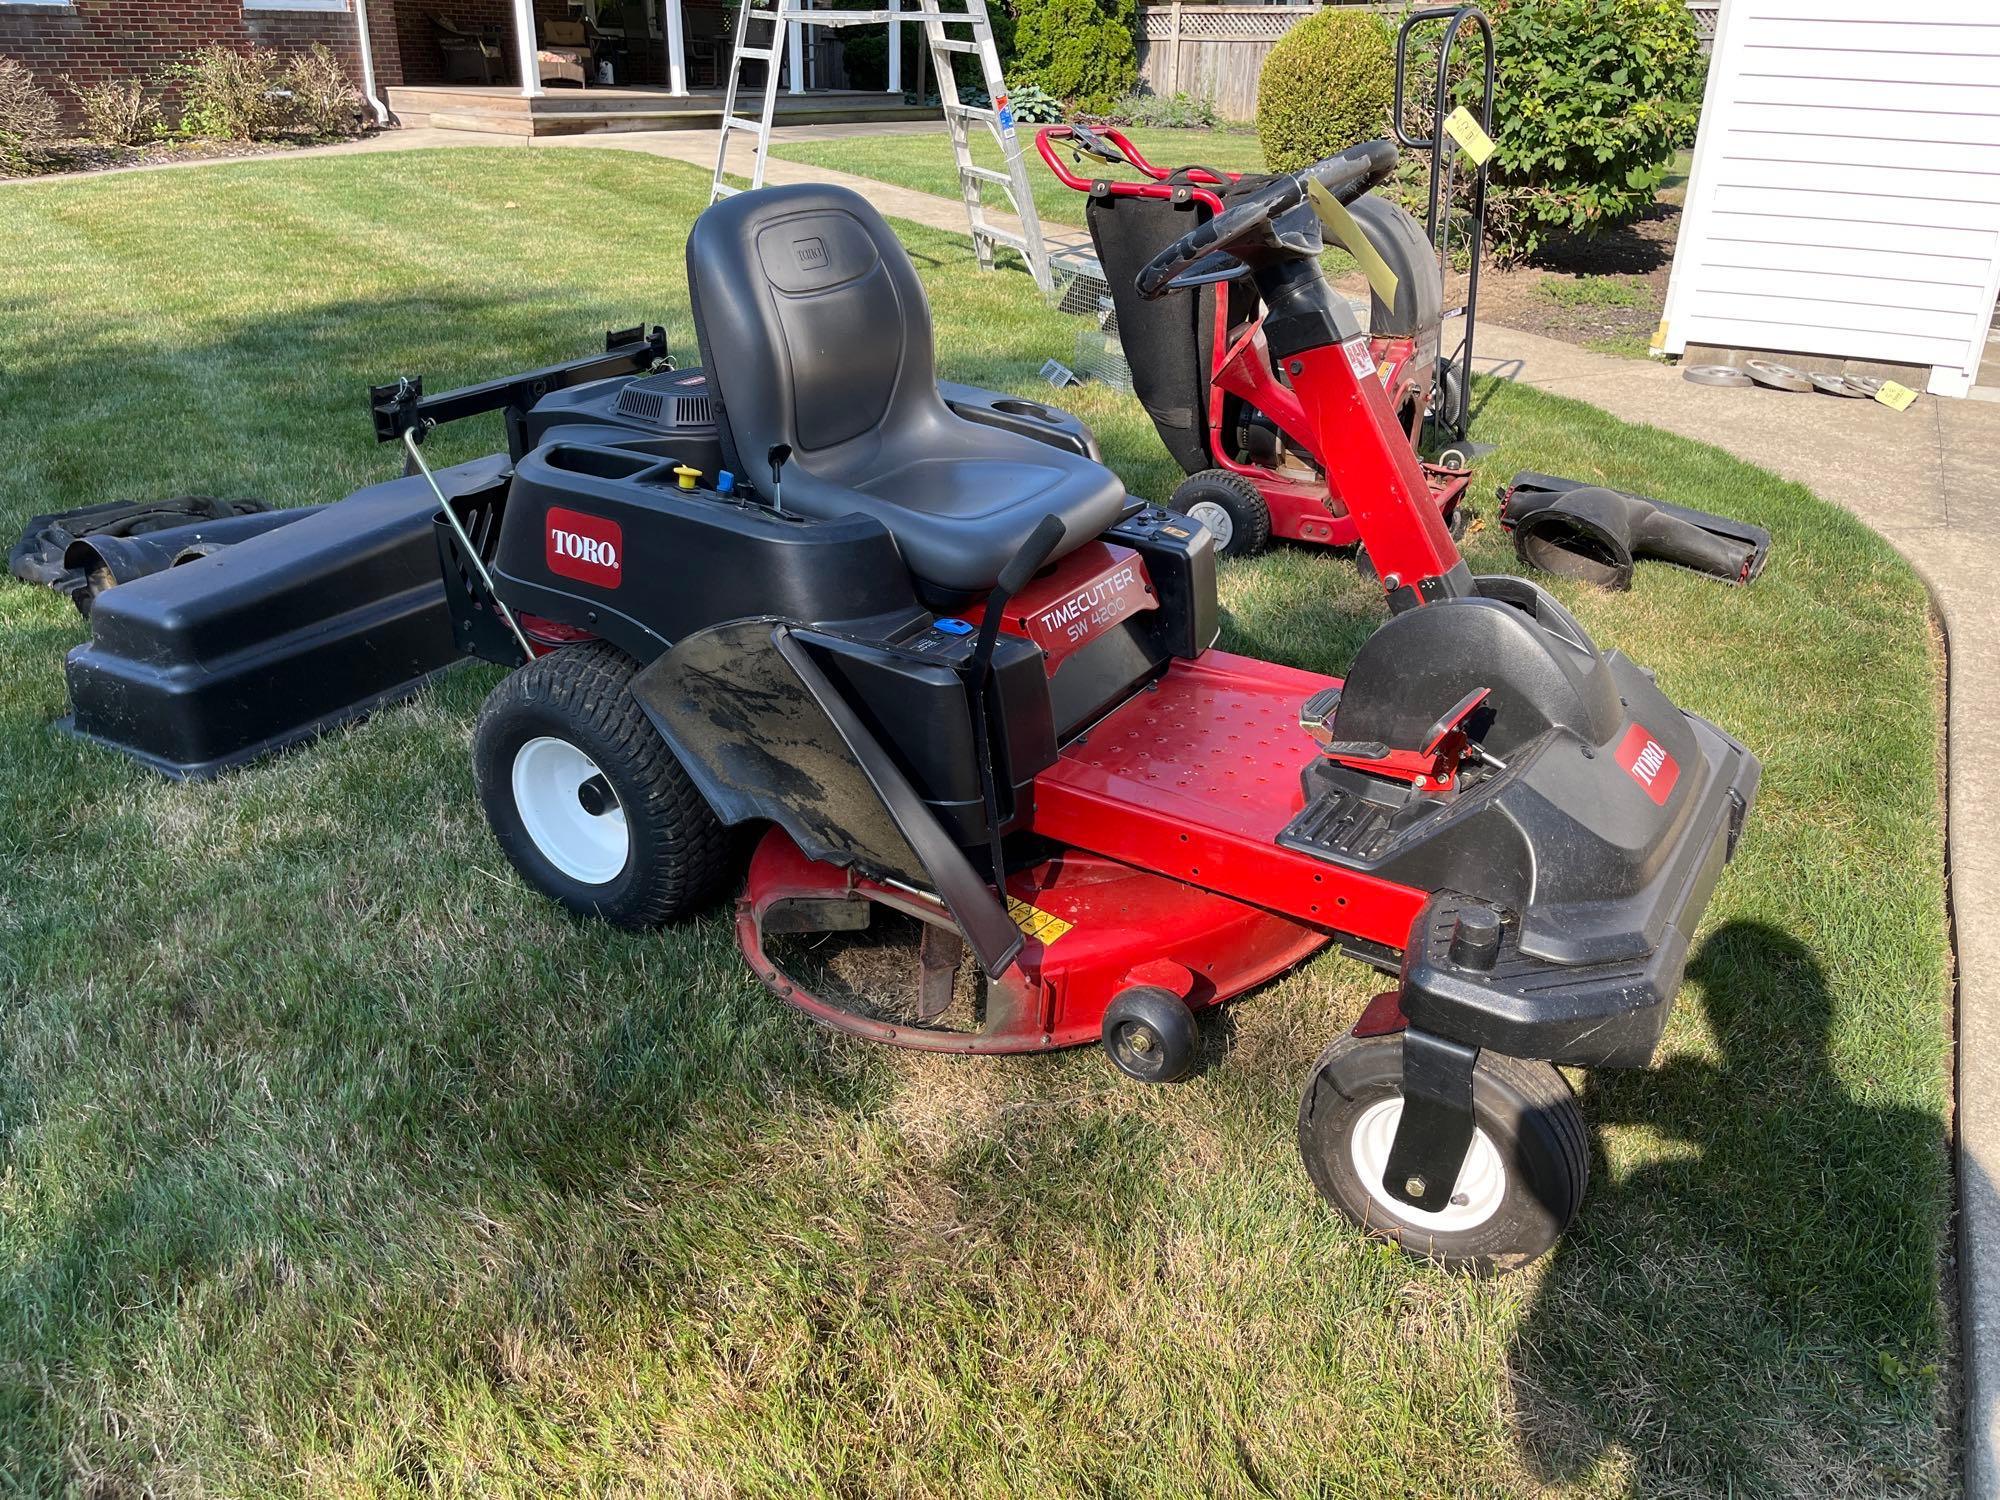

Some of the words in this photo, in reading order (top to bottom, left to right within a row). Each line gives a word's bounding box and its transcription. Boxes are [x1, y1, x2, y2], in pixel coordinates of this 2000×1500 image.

[552, 528, 616, 567] TORO
[1041, 568, 1134, 632] TIMECUTTER
[1067, 618, 1088, 642] SW
[1091, 597, 1126, 625] 4200
[1631, 740, 1665, 787] TORO
